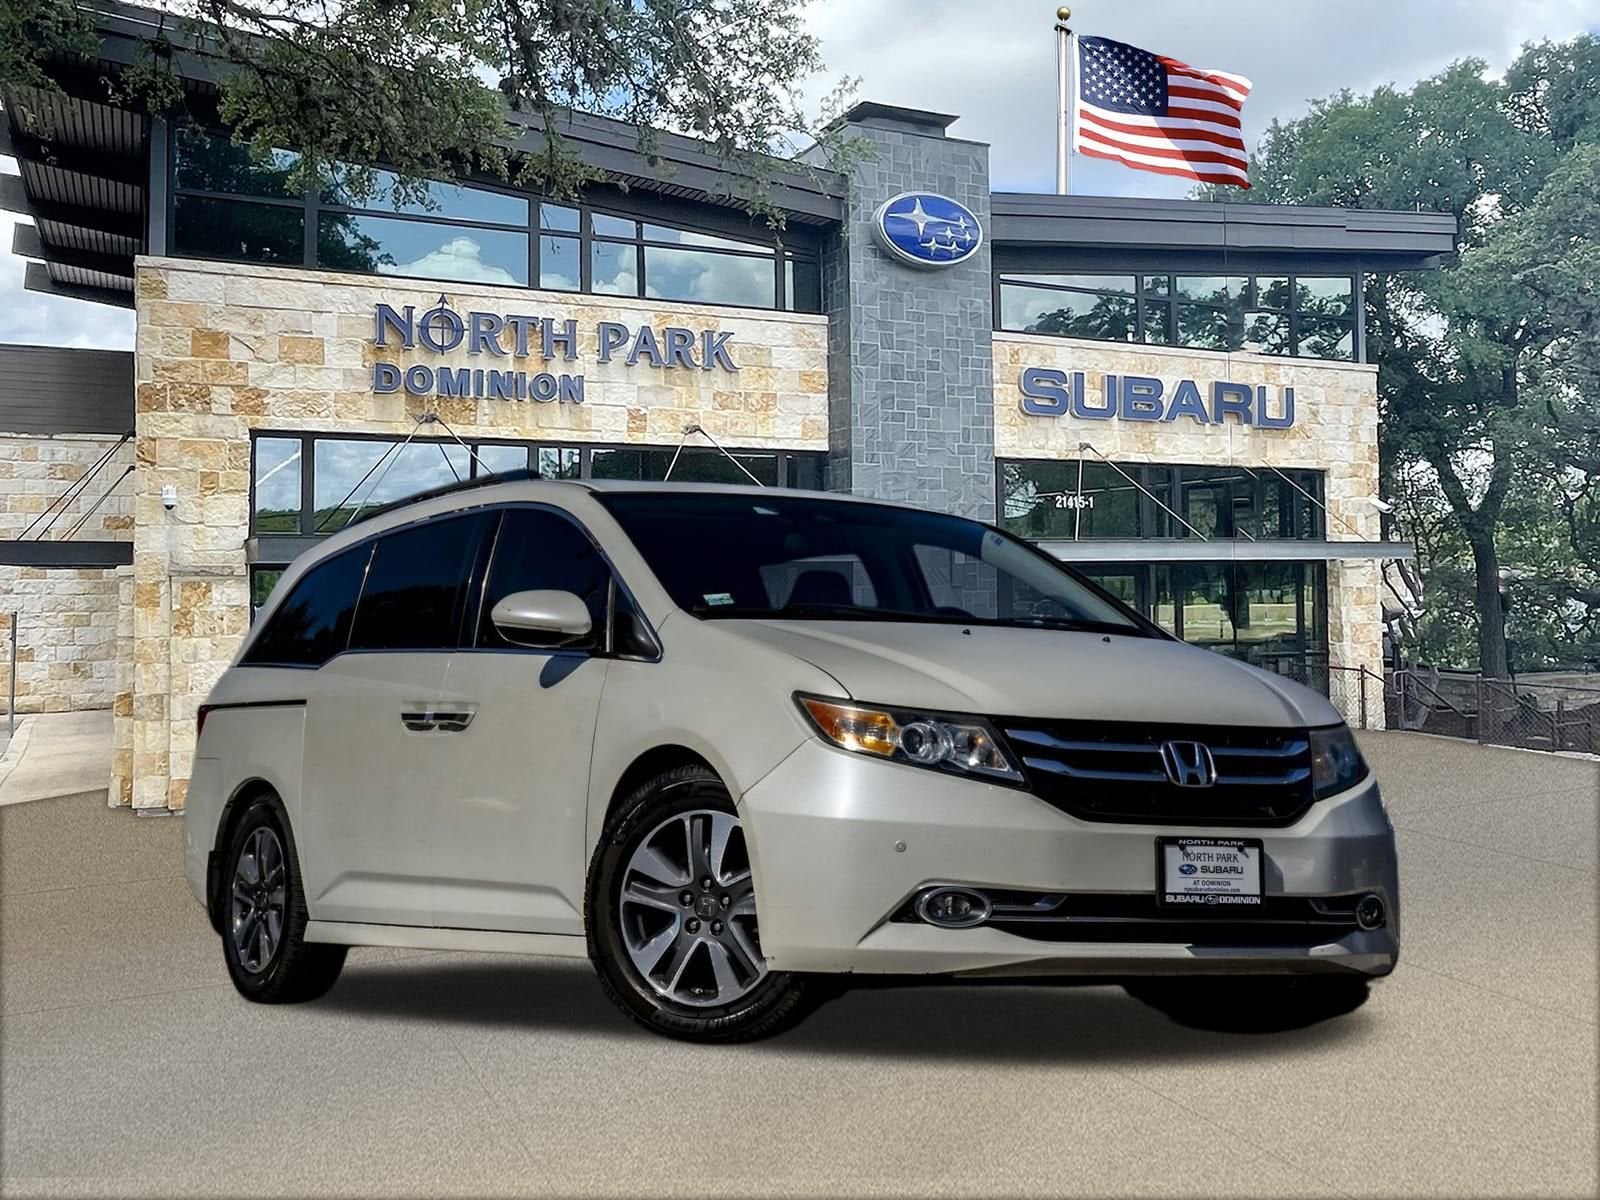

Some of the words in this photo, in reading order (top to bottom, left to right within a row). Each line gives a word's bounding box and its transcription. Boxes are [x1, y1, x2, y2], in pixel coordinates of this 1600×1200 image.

[374, 300, 581, 361] NORTH
[596, 320, 742, 373] PARK
[373, 361, 585, 404] DOMINION
[1019, 367, 1295, 430] SUBARU
[1182, 851, 1213, 862] NORTH
[1216, 853, 1239, 863] PARK
[1200, 865, 1244, 875] SUBARU
[1165, 894, 1205, 904] SUBARU
[1219, 895, 1261, 905] DOMINION
